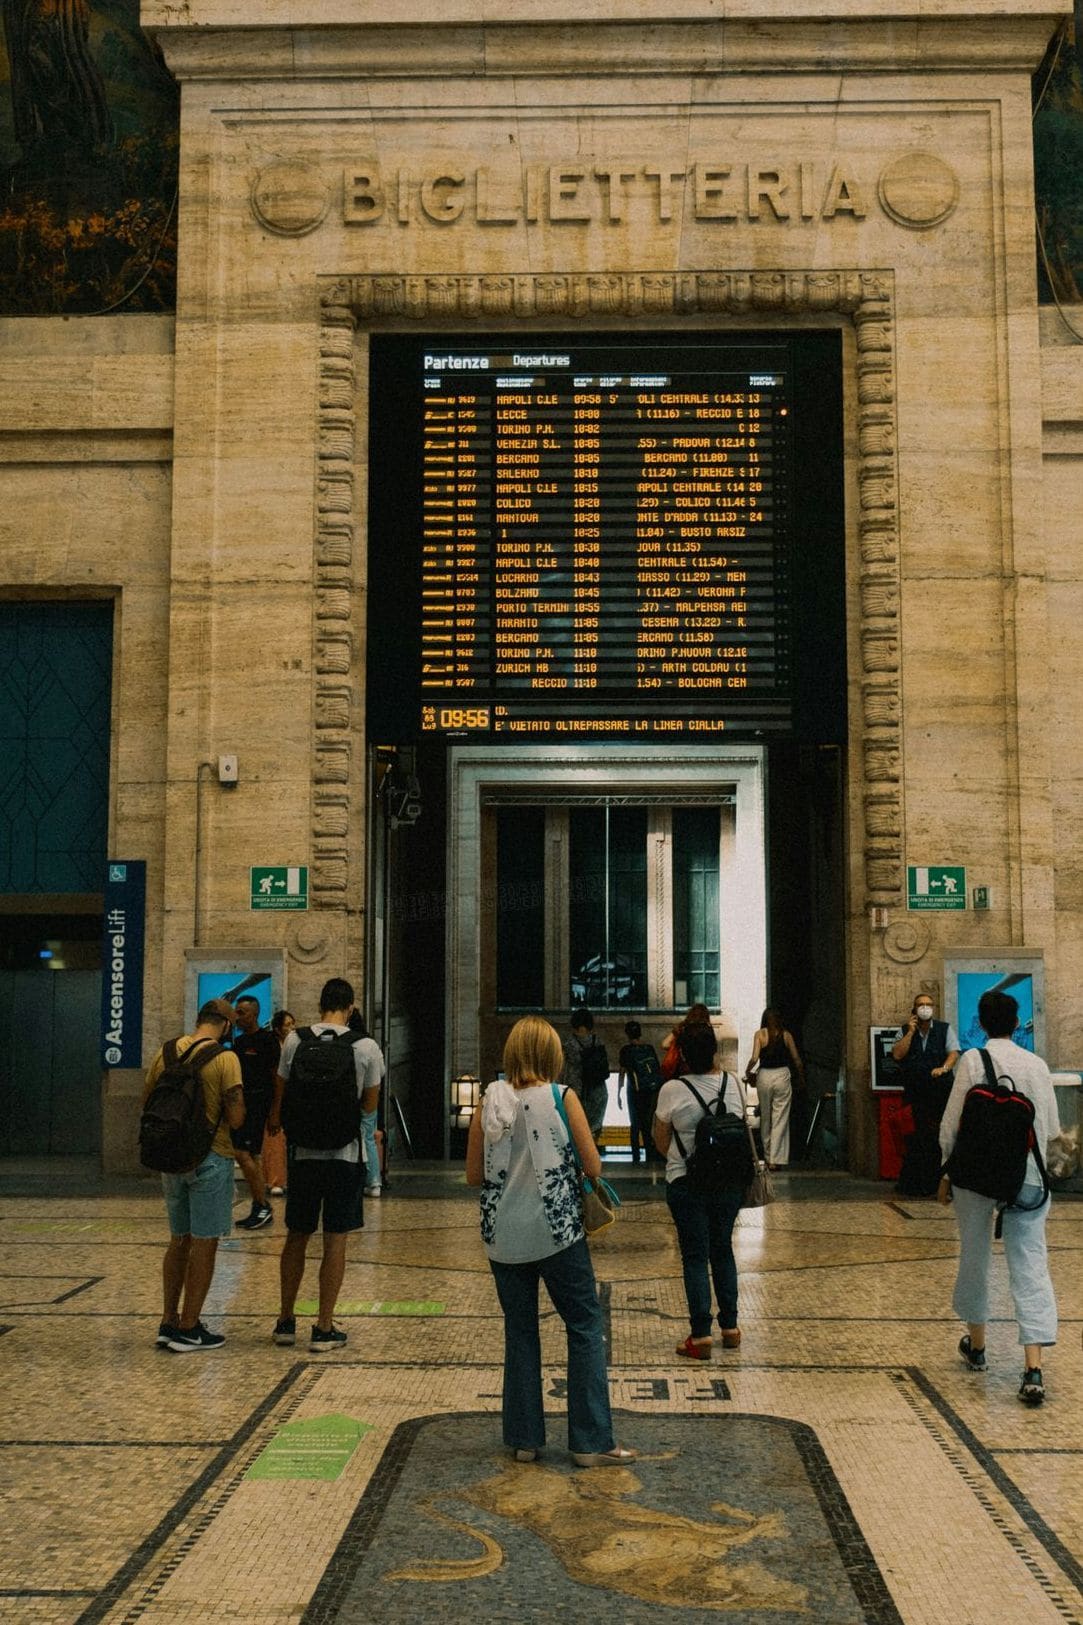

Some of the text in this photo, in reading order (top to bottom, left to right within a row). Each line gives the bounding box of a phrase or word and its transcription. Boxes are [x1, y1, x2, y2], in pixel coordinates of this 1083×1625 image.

[344, 163, 868, 226] BIGLIETTERIA
[424, 355, 490, 370] Partenze
[513, 354, 571, 368] Departures
[496, 395, 532, 405] NAPOLI
[536, 395, 559, 405] C.LE
[659, 394, 709, 404] CENTRALE
[748, 393, 761, 403] 13
[496, 409, 528, 420] LECCE
[573, 409, 601, 419] 10:00
[748, 408, 761, 418] 18
[497, 424, 532, 434] TORINO
[573, 424, 601, 434] 10:02
[748, 423, 761, 433] 12
[496, 439, 538, 449] VENEZIA
[573, 438, 601, 449] 10:05
[671, 437, 713, 448] PADOVA
[496, 454, 541, 464] BERGAMO
[574, 453, 601, 463] 10:05
[643, 453, 689, 463] BERGAMO
[748, 453, 760, 462] 11
[496, 468, 540, 479] SALERNO
[574, 468, 599, 478] 10:10
[641, 468, 677, 478] (11.24)
[692, 467, 735, 477] FIRENZE
[748, 467, 761, 476] 17
[496, 483, 532, 493] NAPOLI
[536, 483, 558, 493] C.LE
[573, 483, 598, 493] 10:15
[672, 482, 722, 493] CENTRALE
[748, 482, 763, 492] 20
[496, 498, 532, 508] COLICO
[574, 498, 601, 508] 10:20
[675, 497, 712, 507] COLICO
[748, 497, 757, 507] 5
[496, 513, 540, 523] MANTOVA
[574, 512, 602, 523] 10:20
[703, 512, 738, 522] (11.13)
[748, 512, 764, 522] 24
[574, 528, 600, 537] 10:25
[679, 527, 712, 537] BUSTO
[497, 543, 531, 553] TORINO
[573, 542, 601, 553] 10:30
[665, 542, 701, 552] (11.35)
[496, 558, 531, 568] NAPOLI
[536, 558, 557, 568] C.LE
[573, 557, 601, 567] 10:40
[637, 557, 687, 567] CENTRALE
[691, 557, 728, 568] (11.54)
[496, 573, 539, 583] LOCARNO
[573, 573, 600, 582] 10:43
[675, 572, 711, 582] (11.29)
[726, 572, 747, 582] MEN
[495, 588, 539, 598] BOLZANO
[574, 587, 600, 597] 10:45
[645, 587, 681, 597] (11.42)
[697, 586, 736, 597] VERONA
[496, 603, 527, 613] PORTO
[533, 603, 569, 612] TERMIN
[575, 602, 600, 613] 10:55
[675, 602, 727, 612] MALPENSA
[496, 618, 538, 628] TARANTO
[574, 617, 599, 627] 11:05
[641, 617, 680, 628] CESENA
[496, 633, 539, 643] BERGAMO
[574, 633, 599, 642] 11:05
[679, 632, 714, 642] (11.58)
[496, 648, 530, 658] TORINO
[574, 647, 597, 657] 11:10
[496, 663, 532, 673] ZURICH
[536, 663, 549, 673] HB
[574, 663, 598, 672] 11:10
[661, 662, 687, 672] ARTH
[574, 678, 598, 688] 11:10
[677, 677, 723, 688] BOLOGNA
[727, 677, 747, 688] CEN
[440, 709, 489, 728] 09:56
[509, 721, 551, 731] VIETATO
[555, 720, 629, 731] OLTREPASSARE
[635, 720, 648, 731] LA
[653, 720, 684, 731] LINEA
